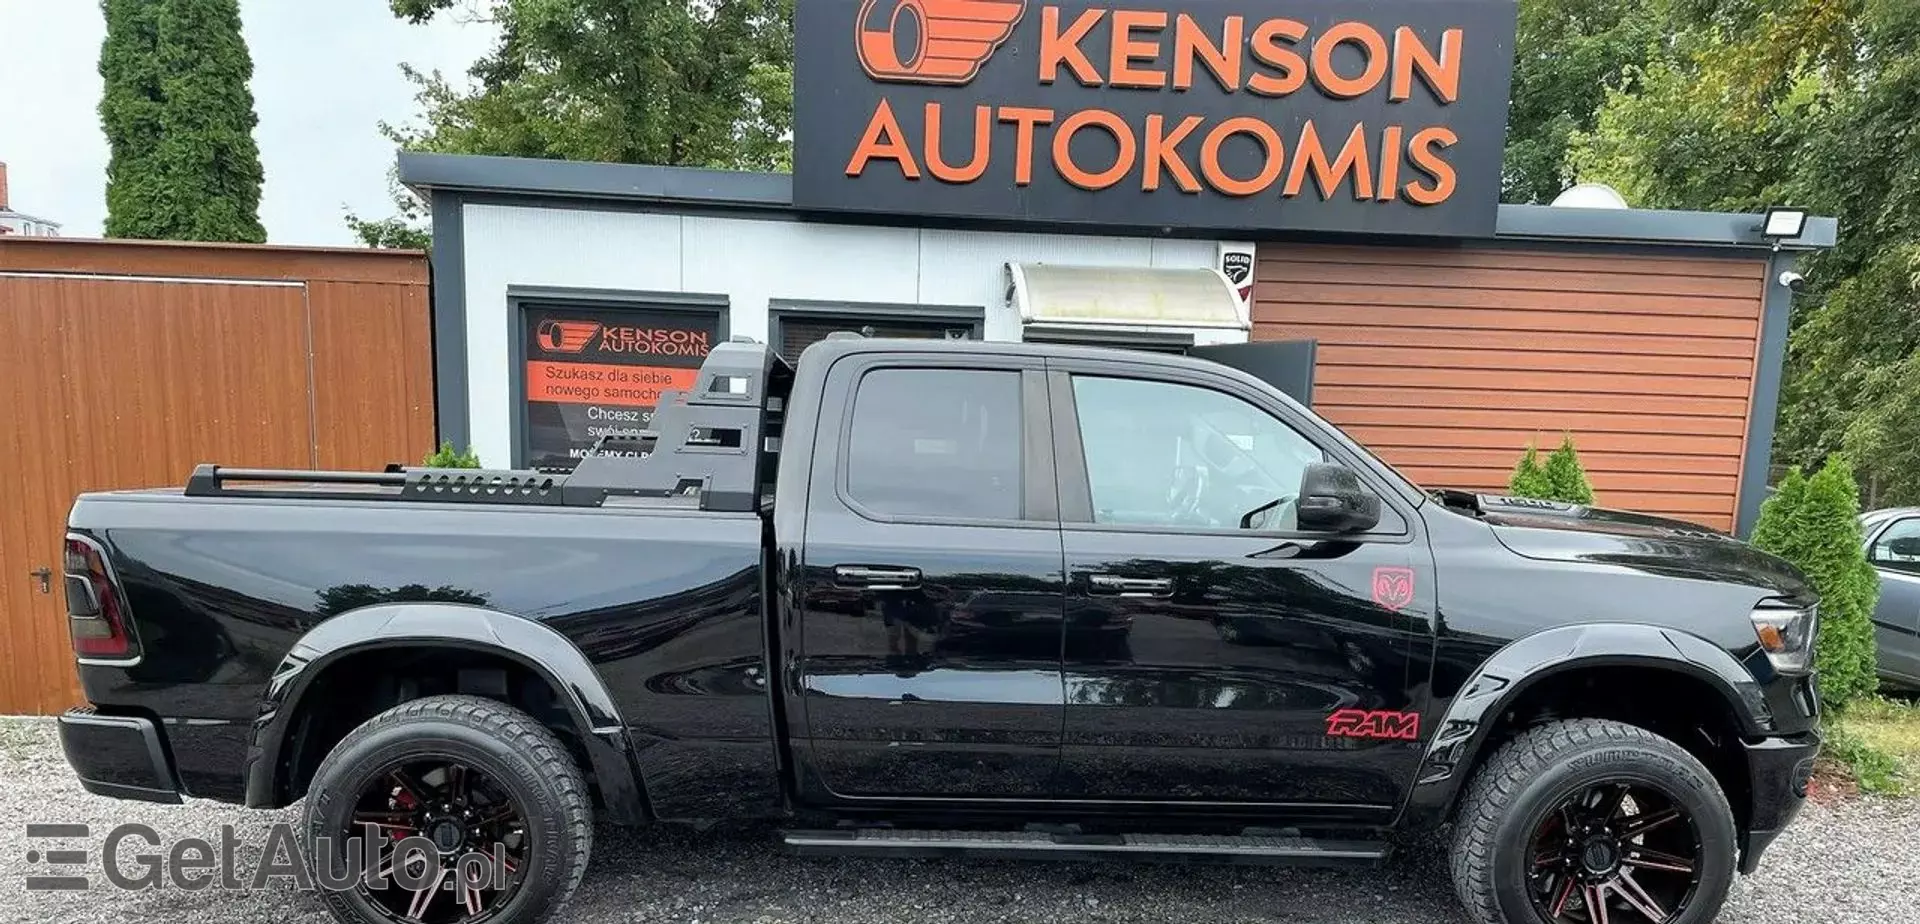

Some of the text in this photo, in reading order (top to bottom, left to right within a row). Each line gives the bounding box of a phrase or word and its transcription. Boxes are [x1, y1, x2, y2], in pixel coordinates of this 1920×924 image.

[1038, 7, 1463, 103] KENSON
[845, 97, 1458, 206] AUTOKOMIS
[1225, 254, 1250, 264] SOLID
[602, 326, 707, 344] KENSON
[598, 340, 710, 357] AUTOKOMIS
[545, 366, 672, 385] Szukasz dla siebie
[545, 384, 600, 399] nowego
[587, 406, 639, 421] Chcesz
[1325, 708, 1420, 741] RAM
